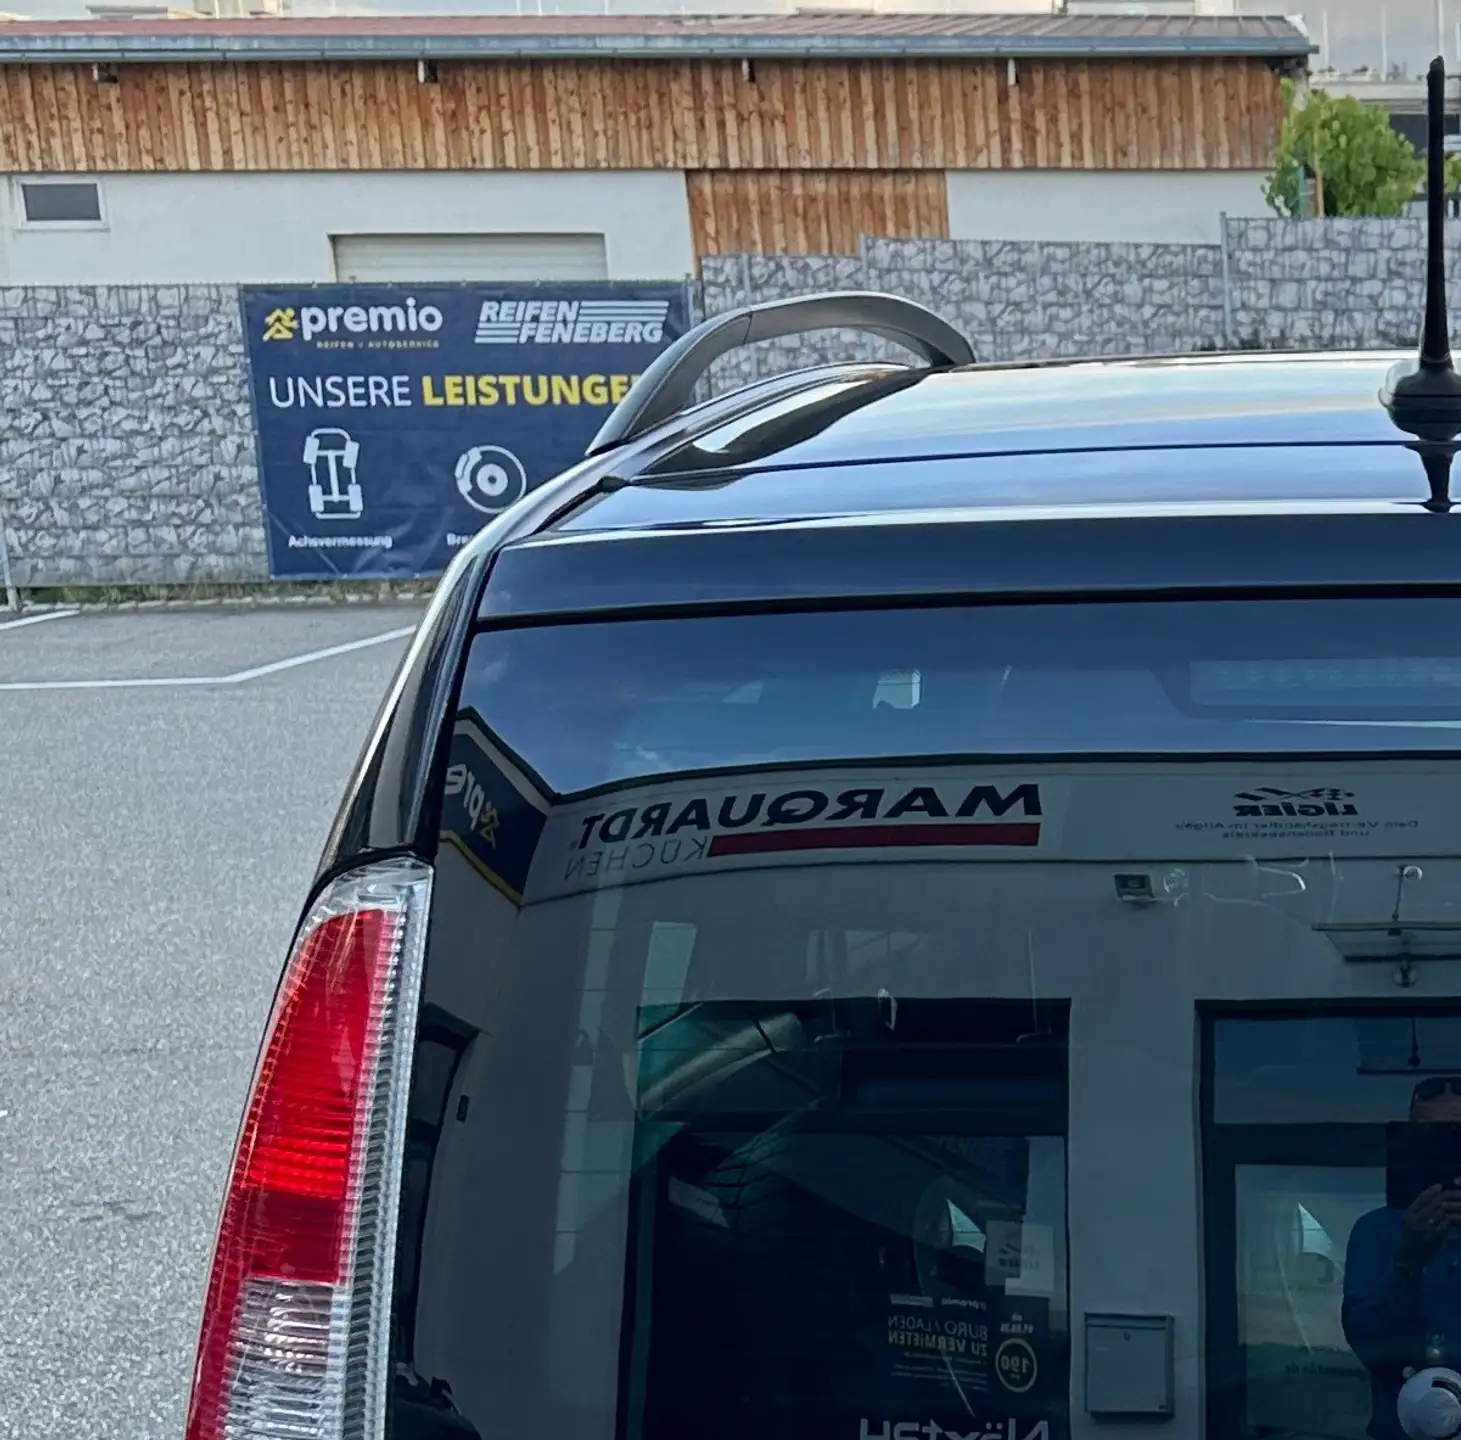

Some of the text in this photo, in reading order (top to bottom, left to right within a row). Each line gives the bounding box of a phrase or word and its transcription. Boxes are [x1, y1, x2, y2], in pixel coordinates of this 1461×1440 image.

[301, 297, 443, 341] premio
[479, 300, 582, 322] REIFEN
[519, 322, 663, 343] FENEBERG
[269, 374, 641, 408] UNSERE LEISTUNGE
